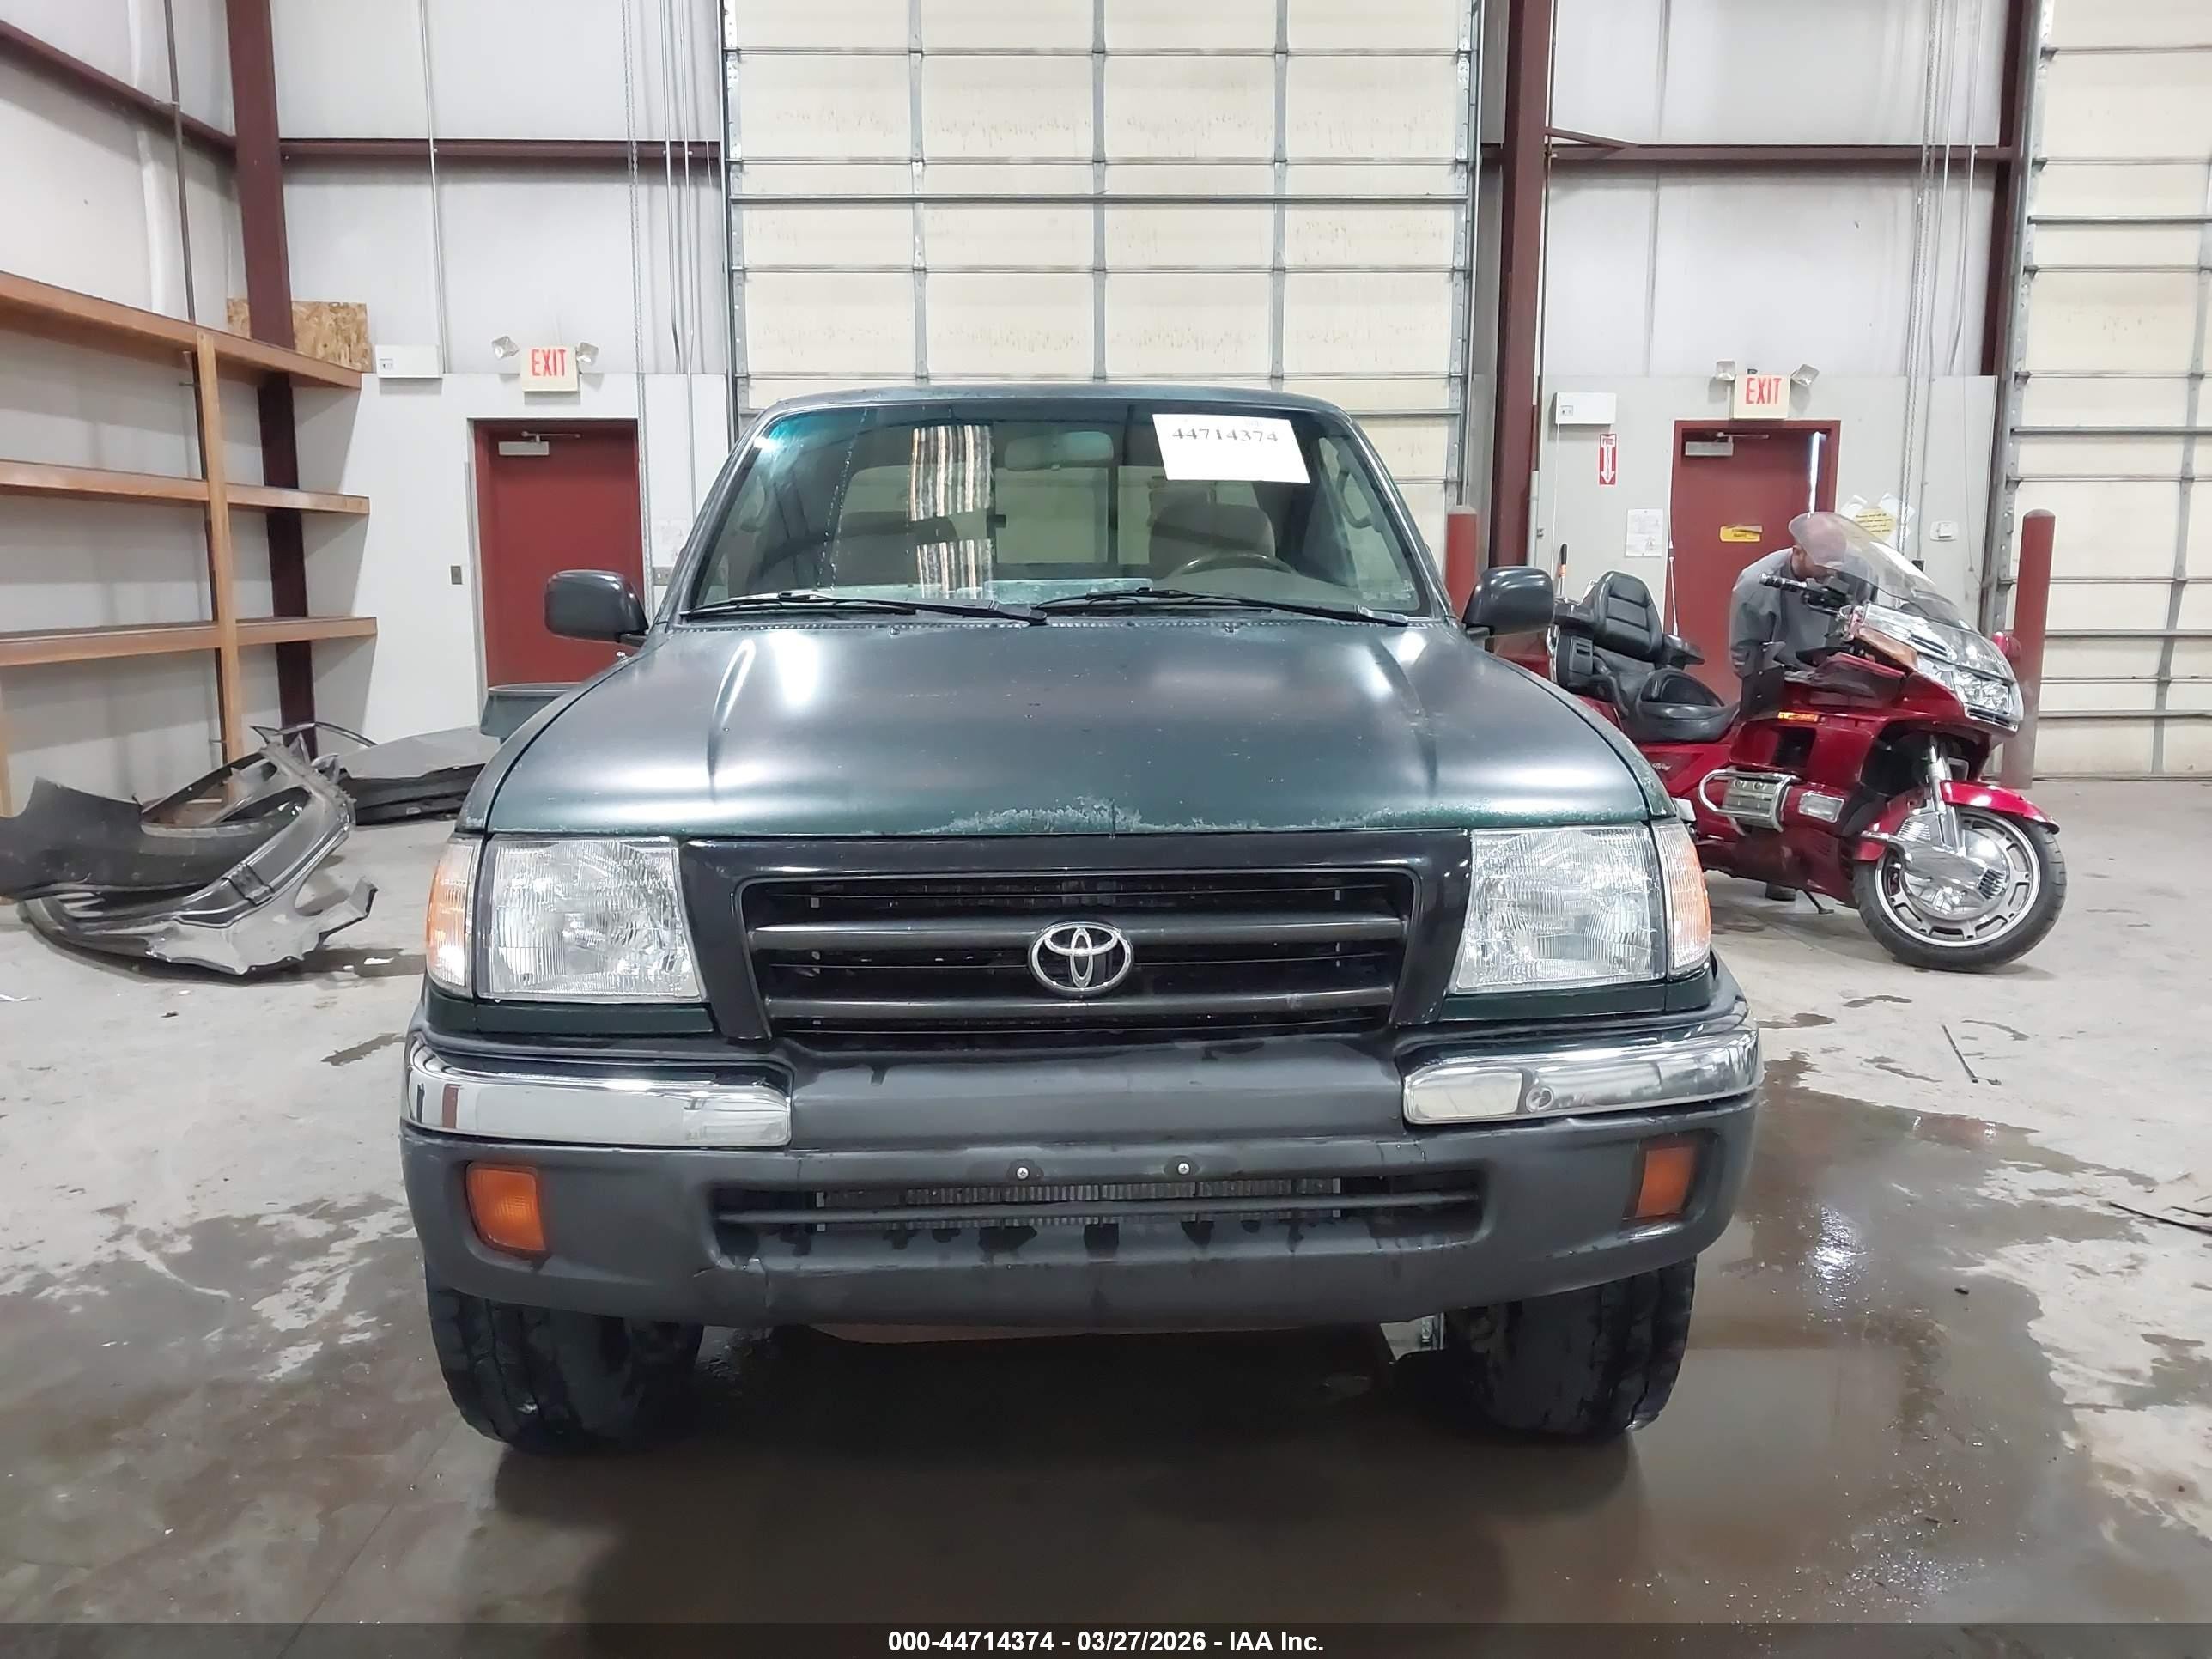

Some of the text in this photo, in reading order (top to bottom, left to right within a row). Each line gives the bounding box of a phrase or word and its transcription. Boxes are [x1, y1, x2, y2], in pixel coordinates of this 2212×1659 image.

[531, 349, 566, 376] EXIT
[1746, 377, 1782, 404] EXIT
[1172, 428, 1279, 442] 44714374
